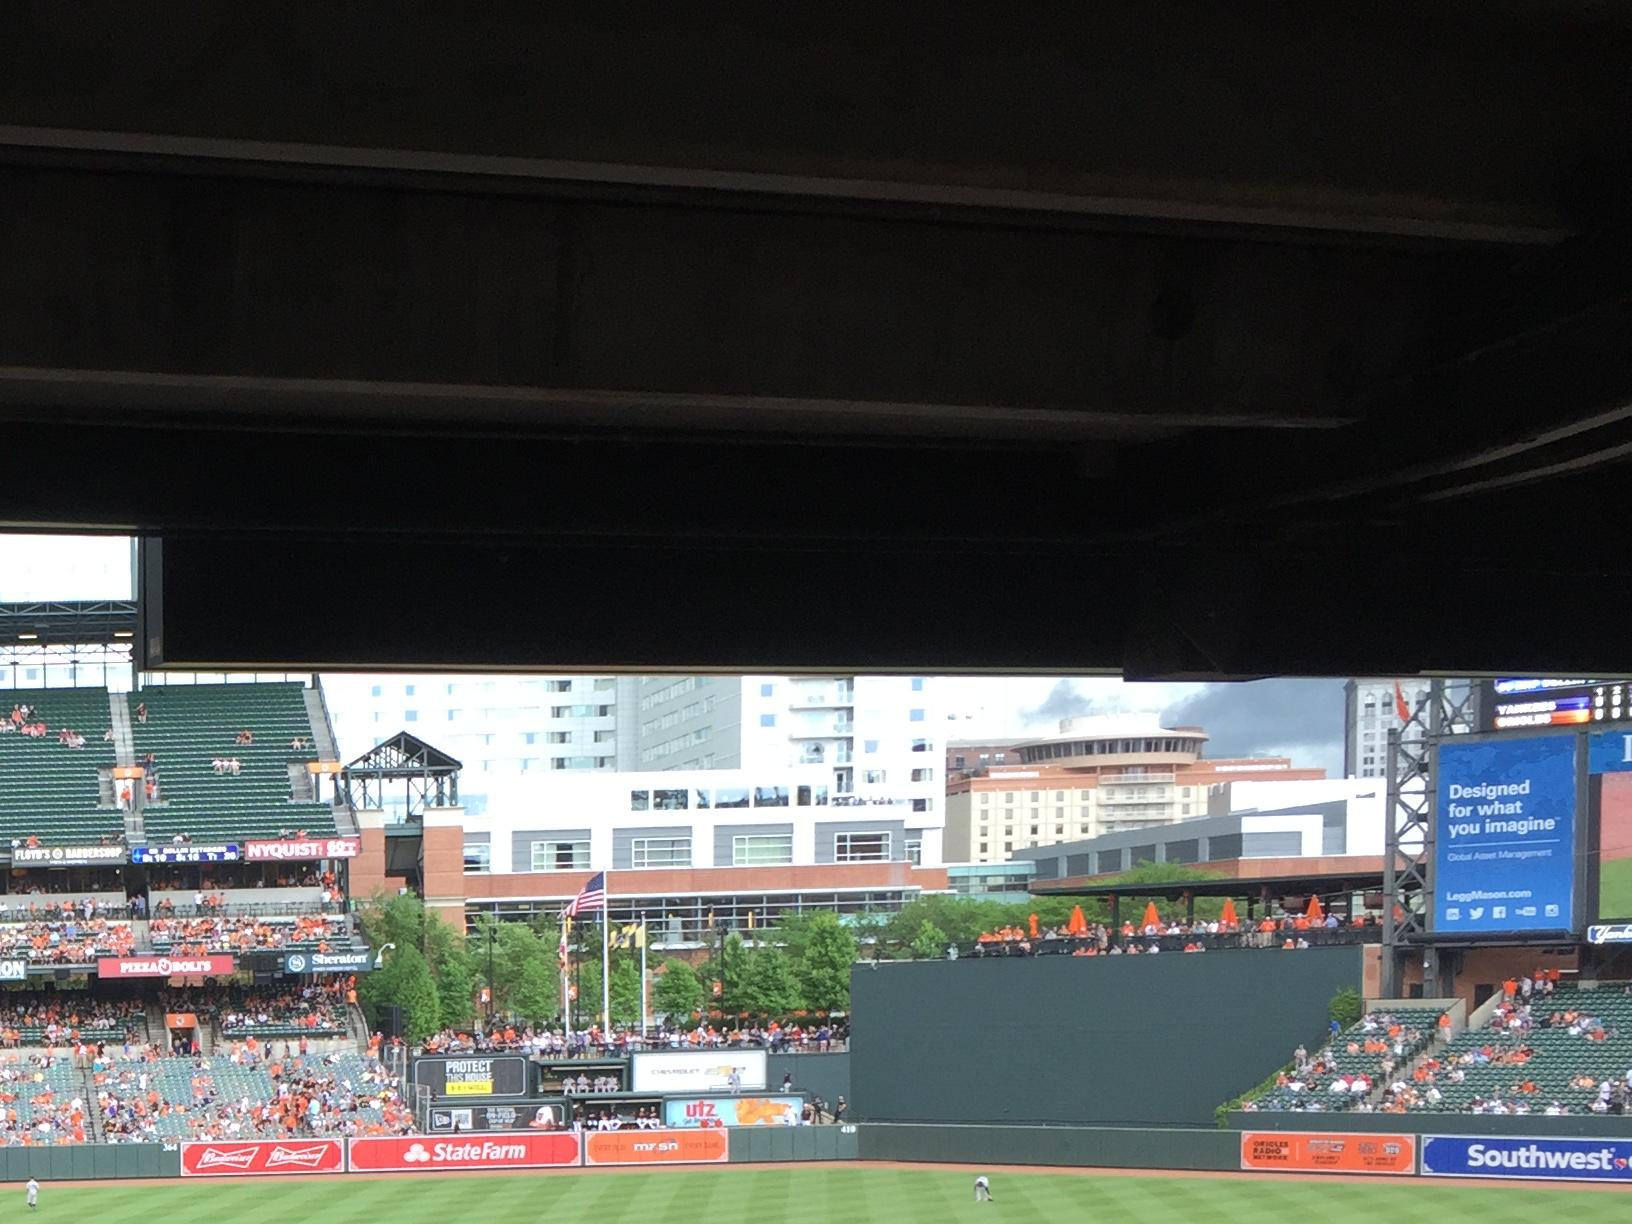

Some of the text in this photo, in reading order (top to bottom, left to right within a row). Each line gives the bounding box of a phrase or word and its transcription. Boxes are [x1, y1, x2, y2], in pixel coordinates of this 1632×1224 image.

[1497, 701, 1556, 715] YANKEES
[1449, 779, 1531, 800] Designed
[1449, 801, 1523, 818] for what
[1448, 823, 1480, 838] you
[15, 847, 123, 860] FLOYD'S BARBERSHOP
[248, 842, 319, 858] NYQUIST
[1448, 849, 1552, 861] Global Asset Management
[1446, 890, 1532, 902] LeggMason.com
[312, 954, 367, 965] Sheraton
[120, 962, 158, 973] PIZZA
[445, 1060, 493, 1073] PROTECT
[446, 1072, 494, 1081] THIS HOUSE
[686, 1101, 716, 1118] utz
[203, 1149, 321, 1163] Budweiser Budweiser
[1467, 1144, 1613, 1170] Southwest
